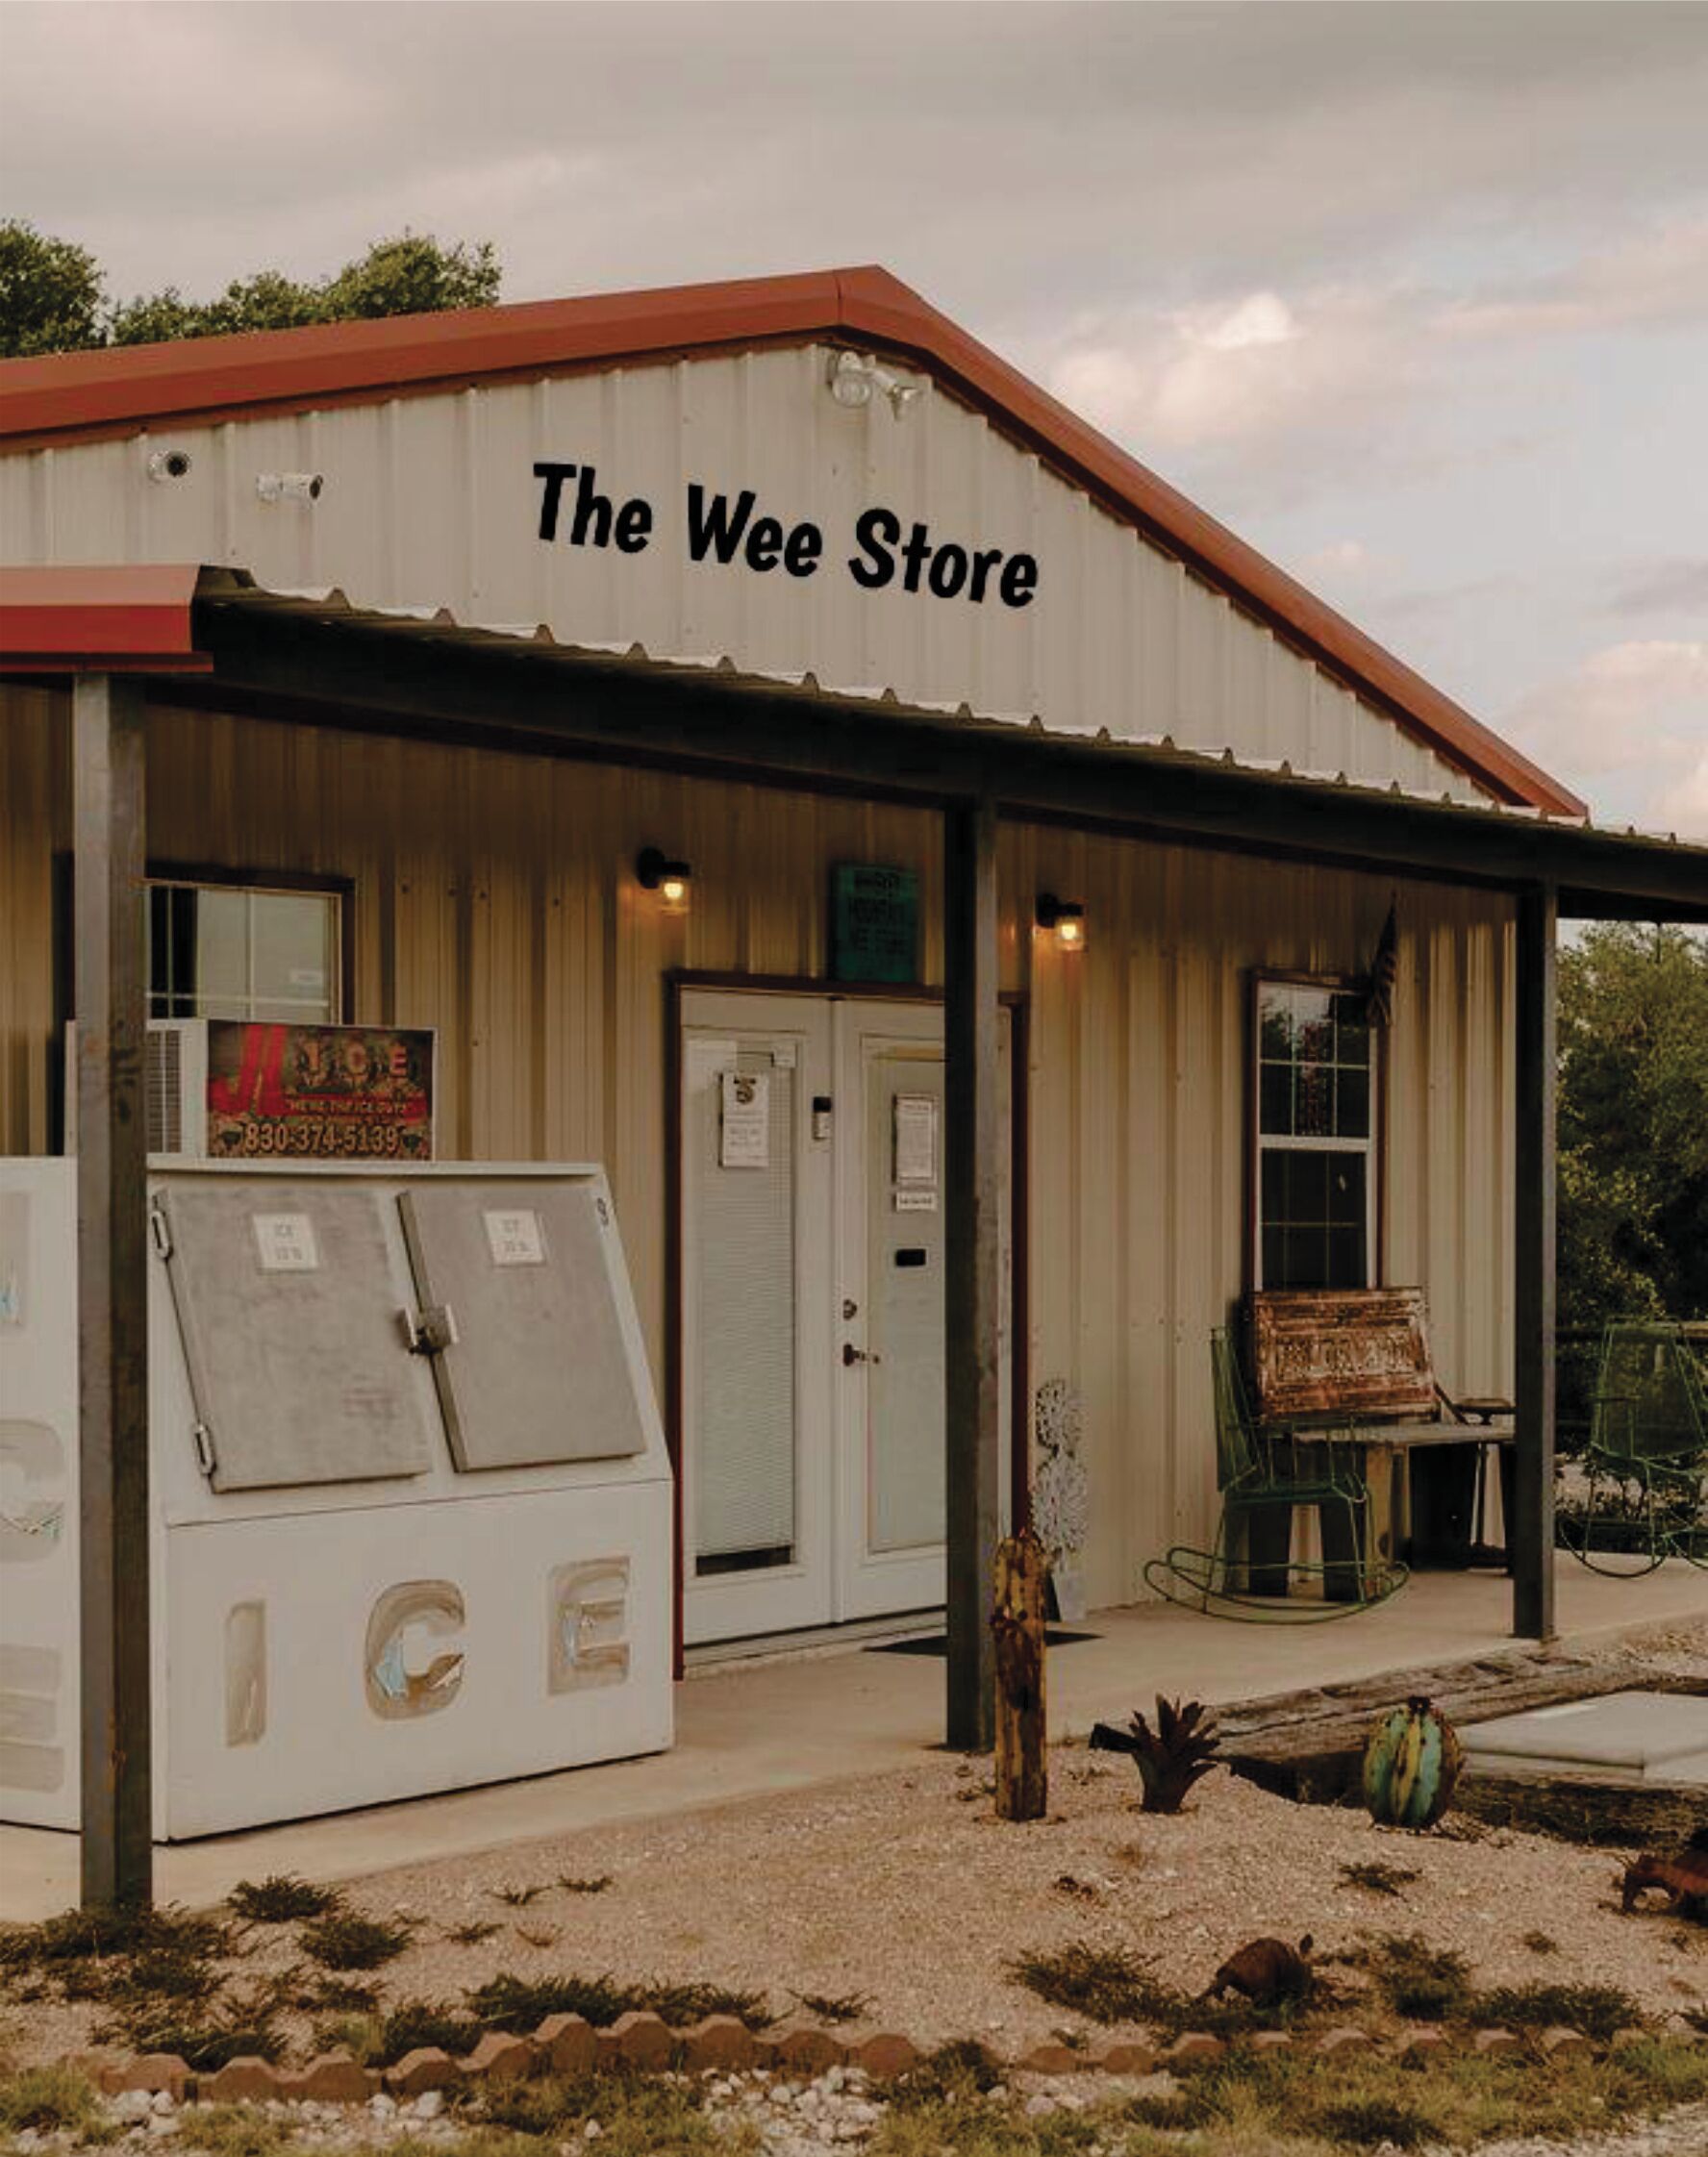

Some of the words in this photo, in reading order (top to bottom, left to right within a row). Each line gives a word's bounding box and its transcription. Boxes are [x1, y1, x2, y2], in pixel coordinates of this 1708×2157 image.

[533, 463, 653, 554] The
[688, 484, 823, 578] Wee
[847, 508, 1038, 608] Store
[245, 1123, 399, 1152] 830-374-5139
[226, 1556, 631, 1748] ICE
